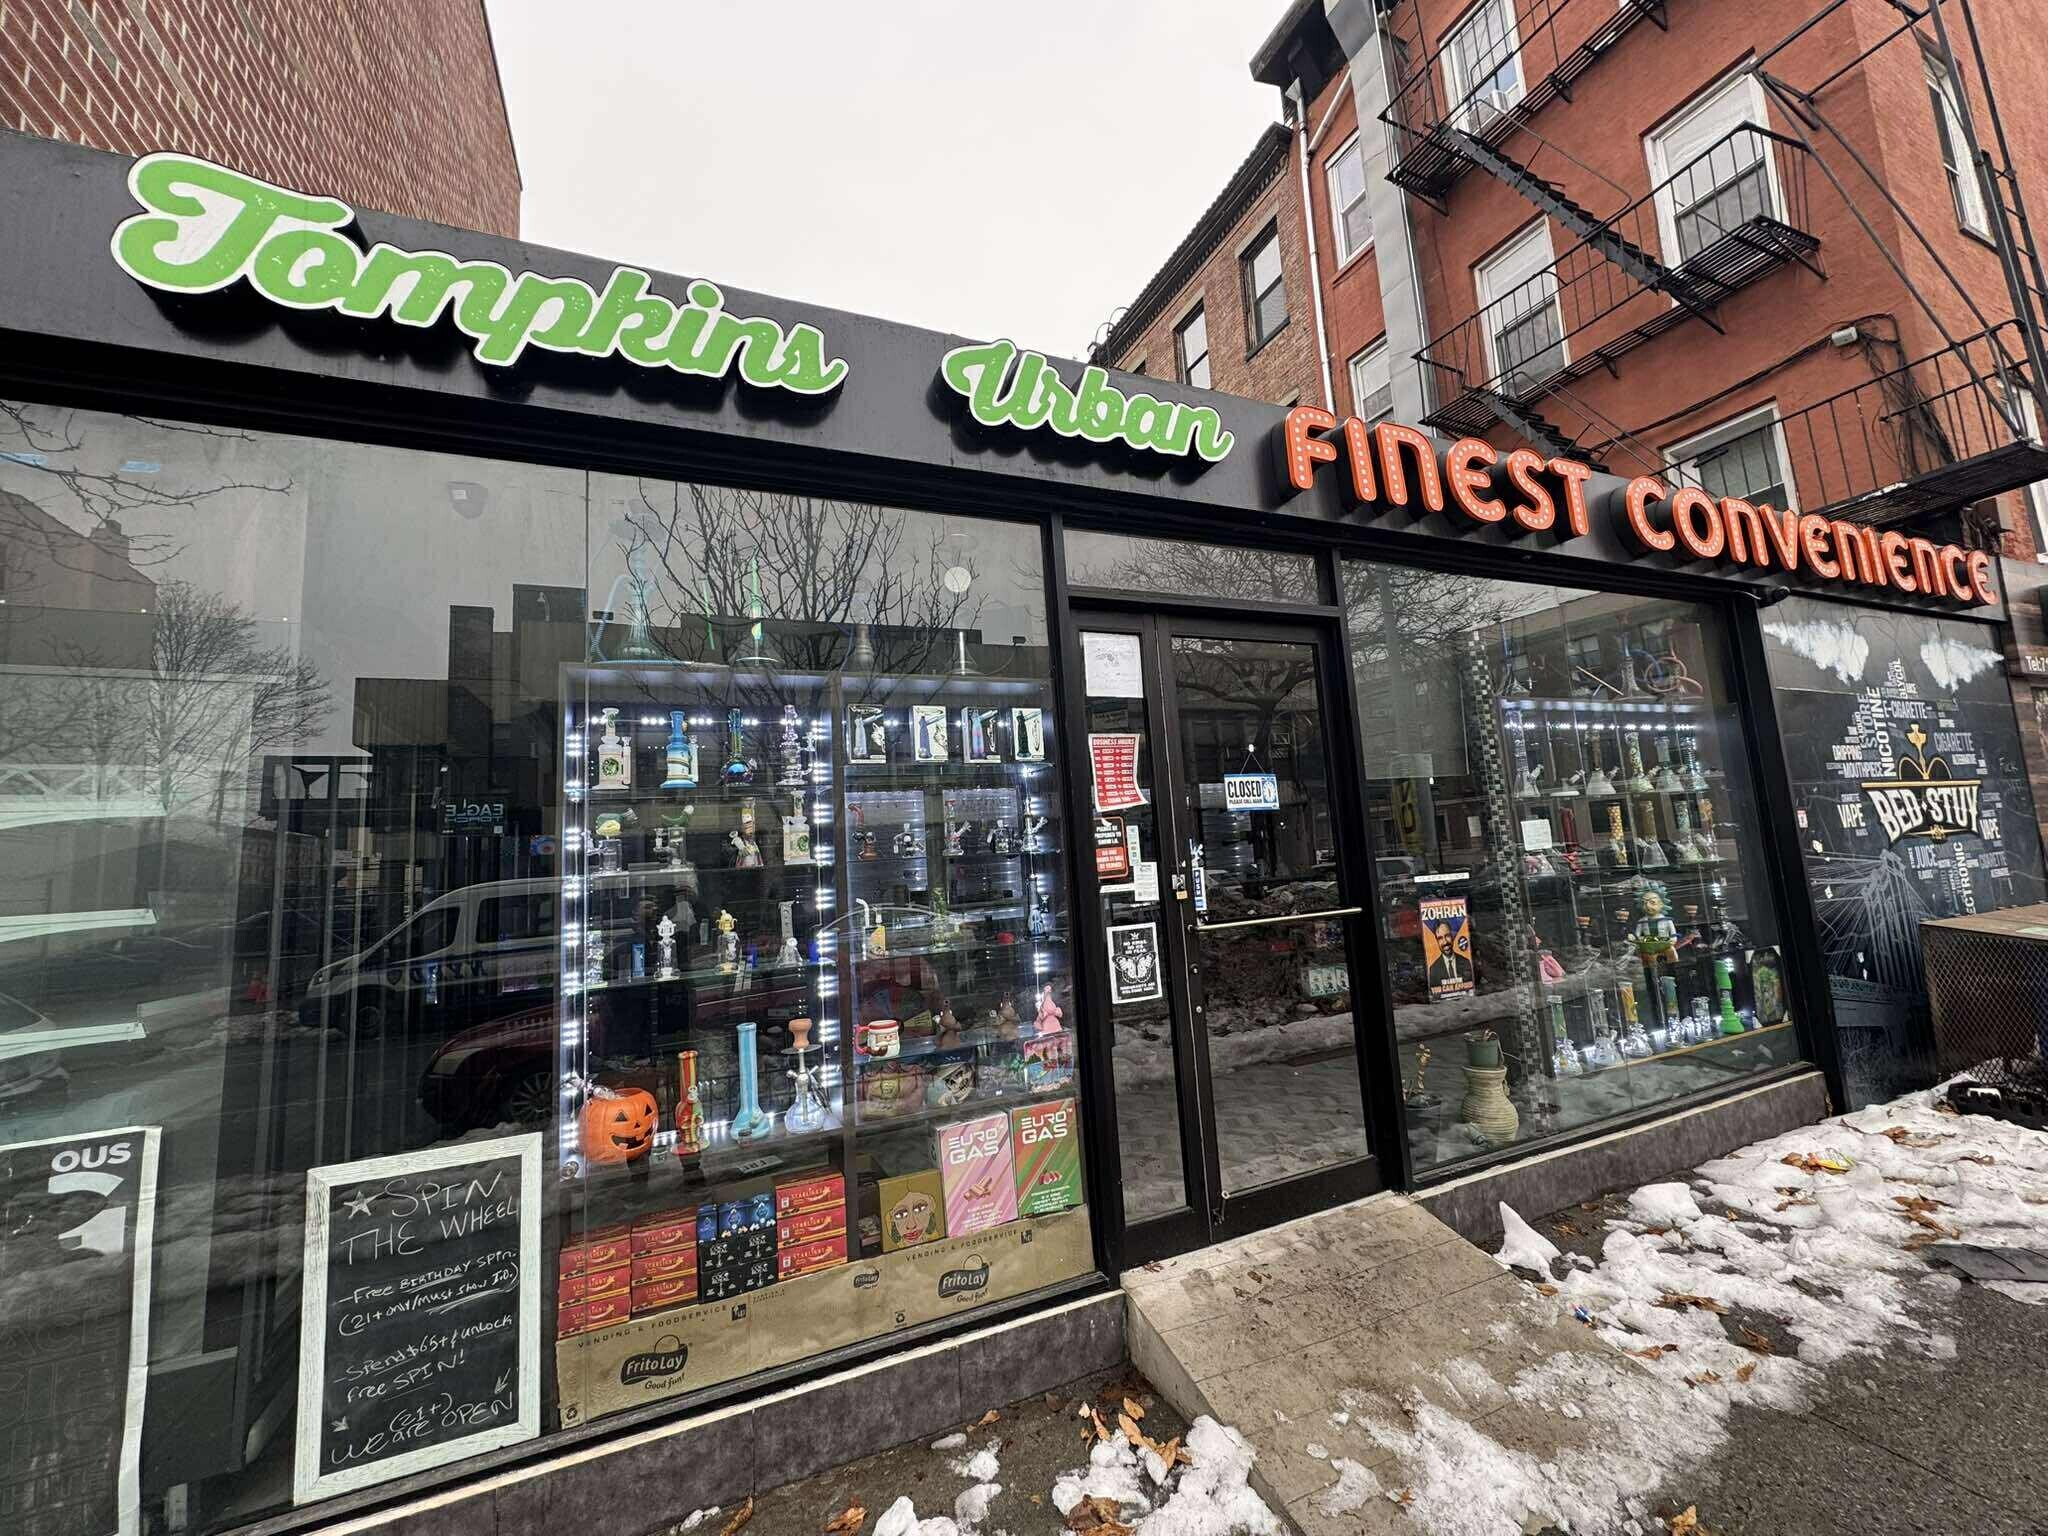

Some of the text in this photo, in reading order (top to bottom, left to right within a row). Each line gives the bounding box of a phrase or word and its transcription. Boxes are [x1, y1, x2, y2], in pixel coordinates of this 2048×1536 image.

[111, 152, 850, 395] Tompkins
[942, 339, 1235, 462] Urban
[1285, 405, 1999, 604] FINEST CONVENIENCE
[1867, 686, 1896, 777] NICOTINE
[1934, 732, 1974, 752] CIGARETTE
[1227, 780, 1261, 798] CLOSED
[1837, 803, 1865, 828] VAPE
[1980, 818, 2001, 840] VAPE
[1421, 905, 1466, 920] ZOHRAN
[1021, 1111, 1067, 1129] EURO
[949, 1128, 998, 1148] EURO
[1022, 1123, 1068, 1144] GAS
[950, 1141, 999, 1164] GAS
[384, 1171, 502, 1216] SPIN
[340, 1196, 519, 1264] THE WHEEL
[906, 1248, 945, 1262] VENDING
[960, 1229, 1018, 1249] FOODSERVICE
[577, 1329, 631, 1348] VENDING
[651, 1305, 727, 1329] FOODSERVICE
[645, 1373, 685, 1390] Good fun!
[441, 1392, 513, 1427] OPEN
